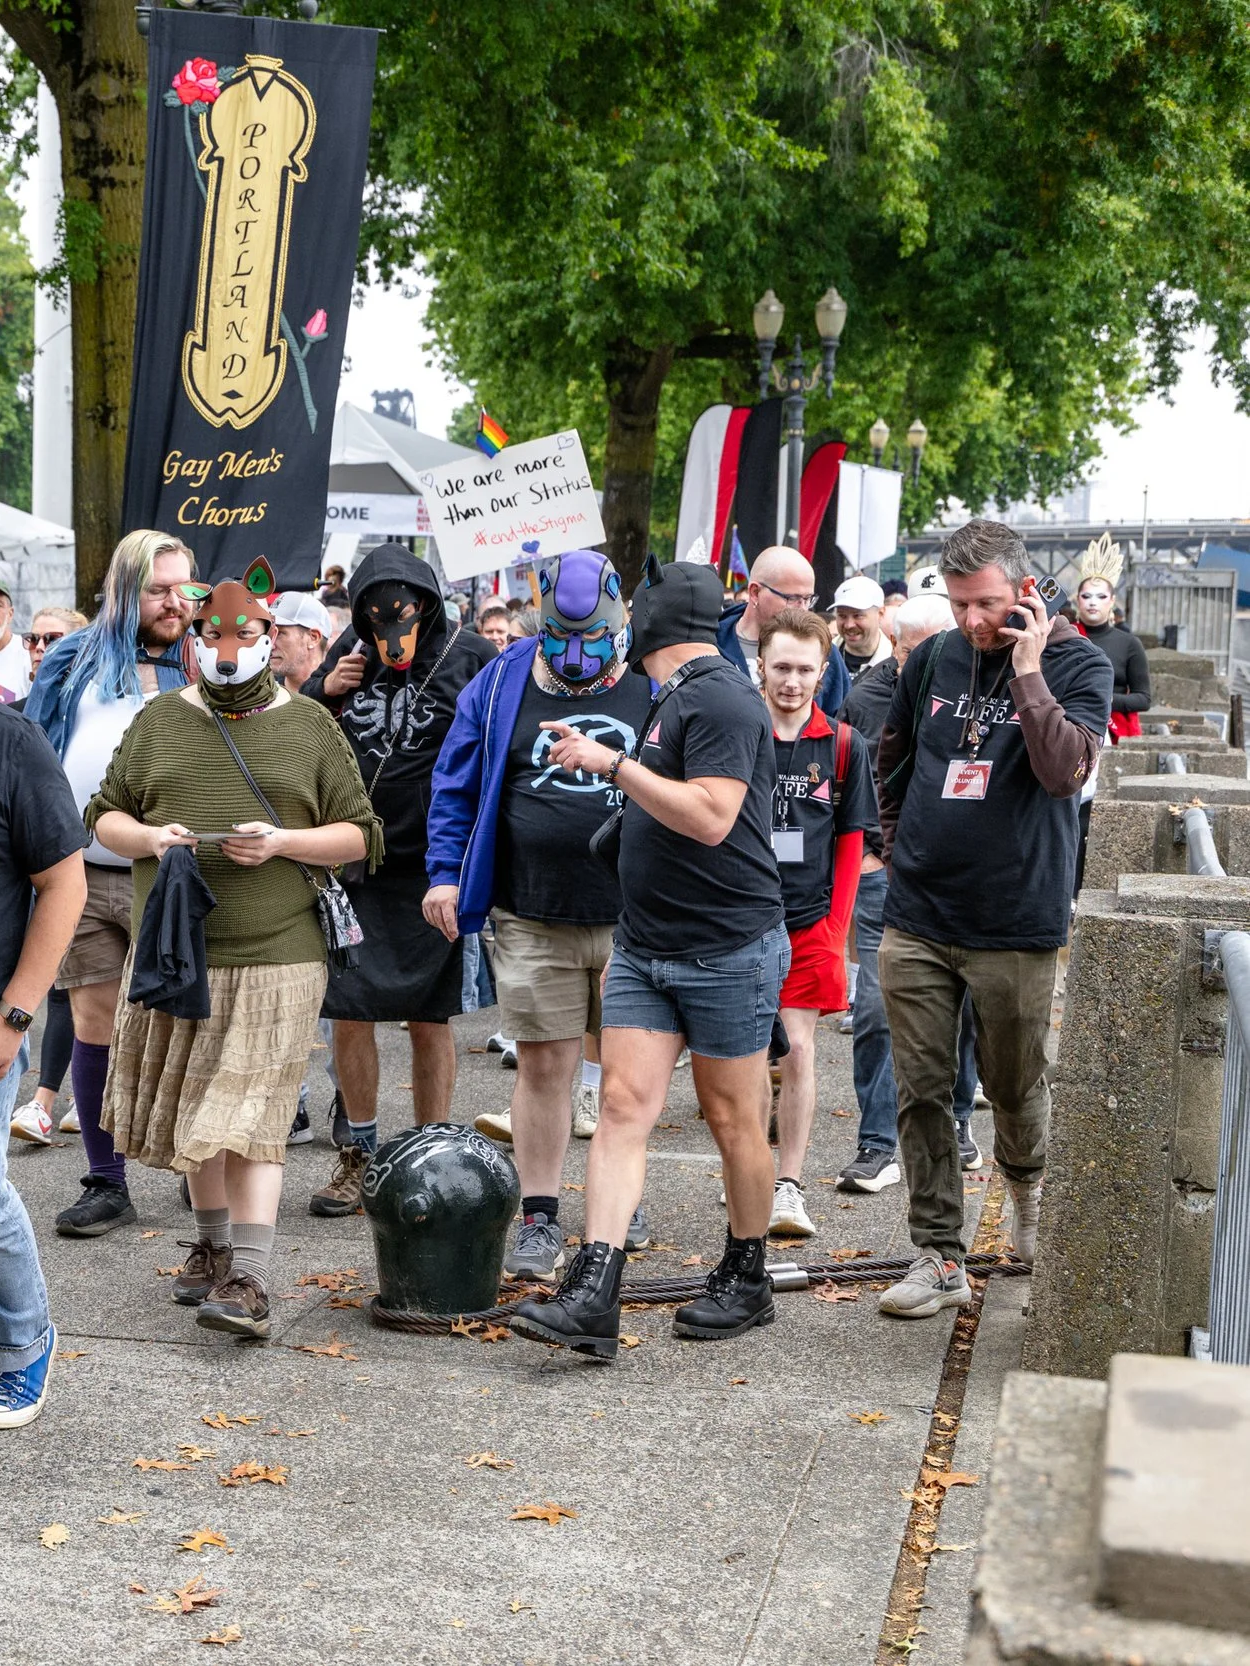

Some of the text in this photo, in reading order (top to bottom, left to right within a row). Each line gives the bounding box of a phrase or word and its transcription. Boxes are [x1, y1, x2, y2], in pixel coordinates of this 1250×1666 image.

[222, 123, 267, 380] PORTLAND
[163, 447, 284, 488] Gay Men's
[436, 455, 565, 499] We are more
[177, 496, 267, 526] Chorus
[443, 503, 484, 526] than
[490, 491, 521, 513] our
